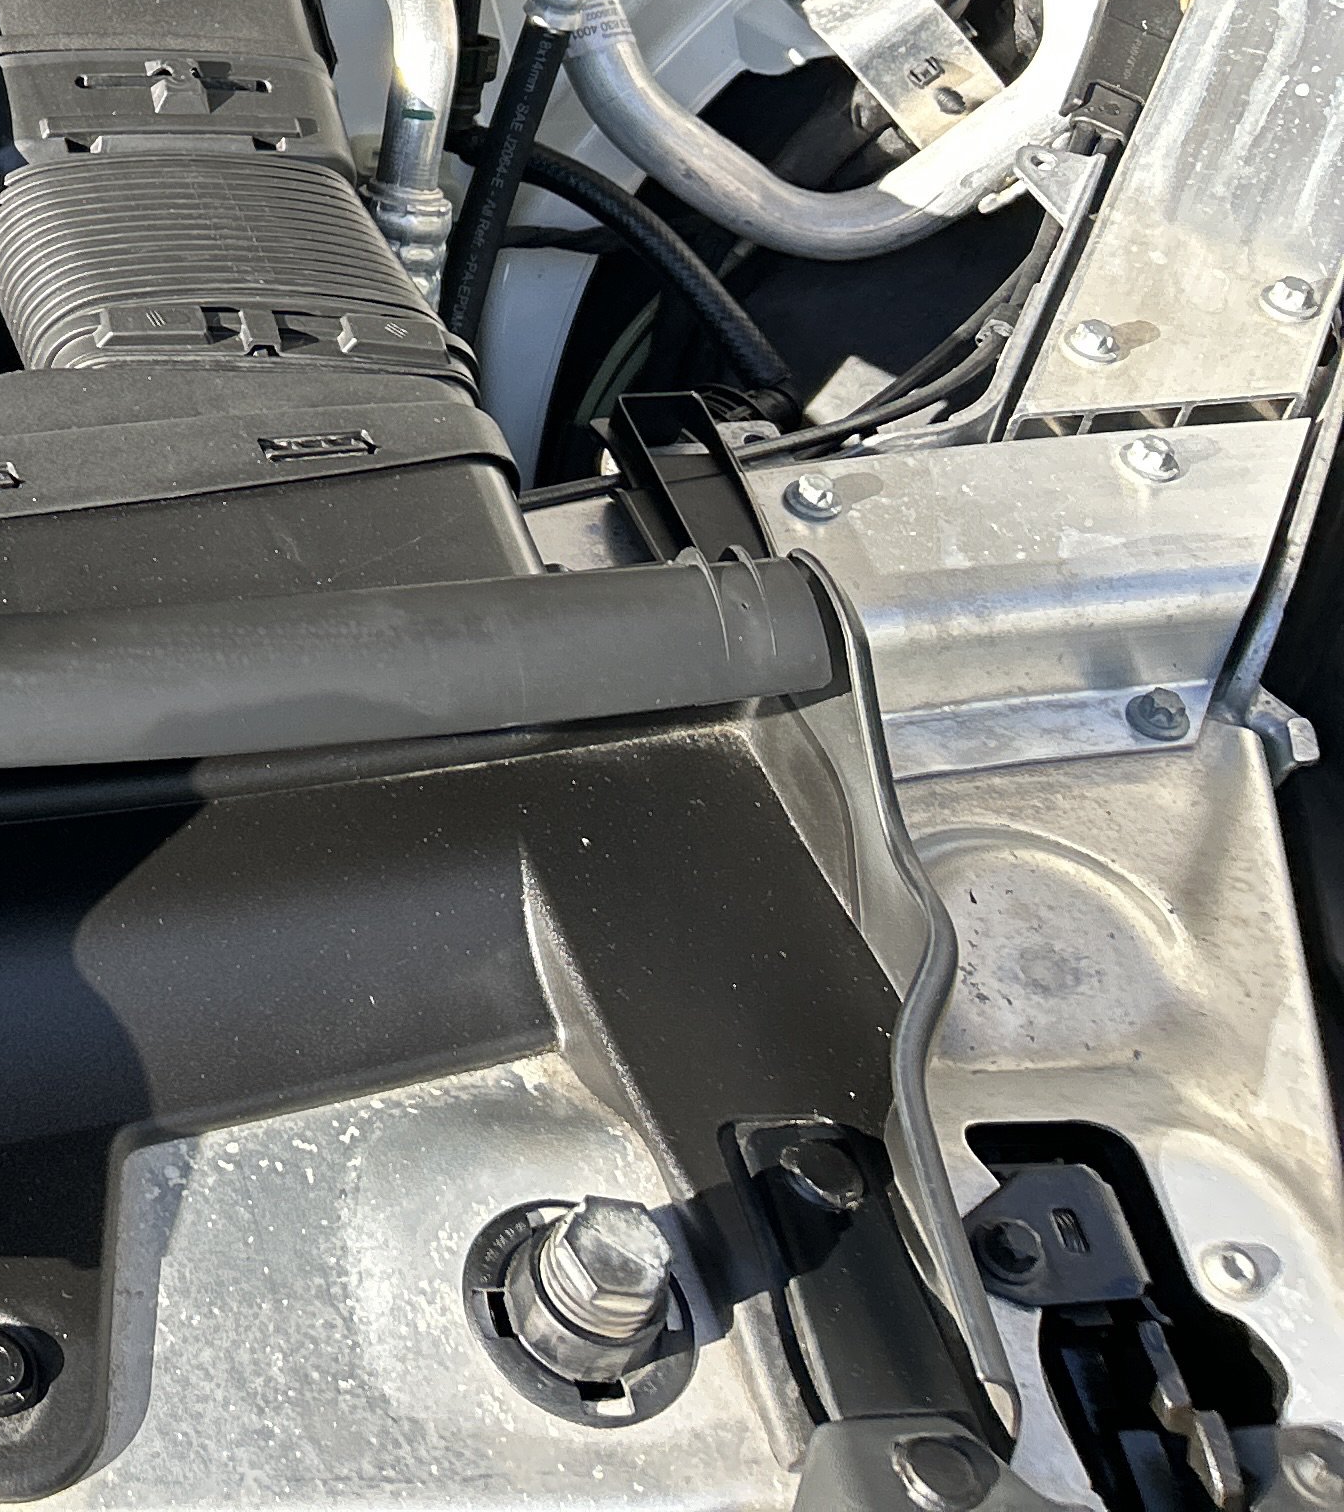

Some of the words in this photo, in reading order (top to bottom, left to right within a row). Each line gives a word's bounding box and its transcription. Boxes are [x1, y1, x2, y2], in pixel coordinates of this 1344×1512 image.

[522, 39, 552, 94] 8x14mm
[508, 101, 530, 132] SAE
[489, 132, 520, 188] J2064-E
